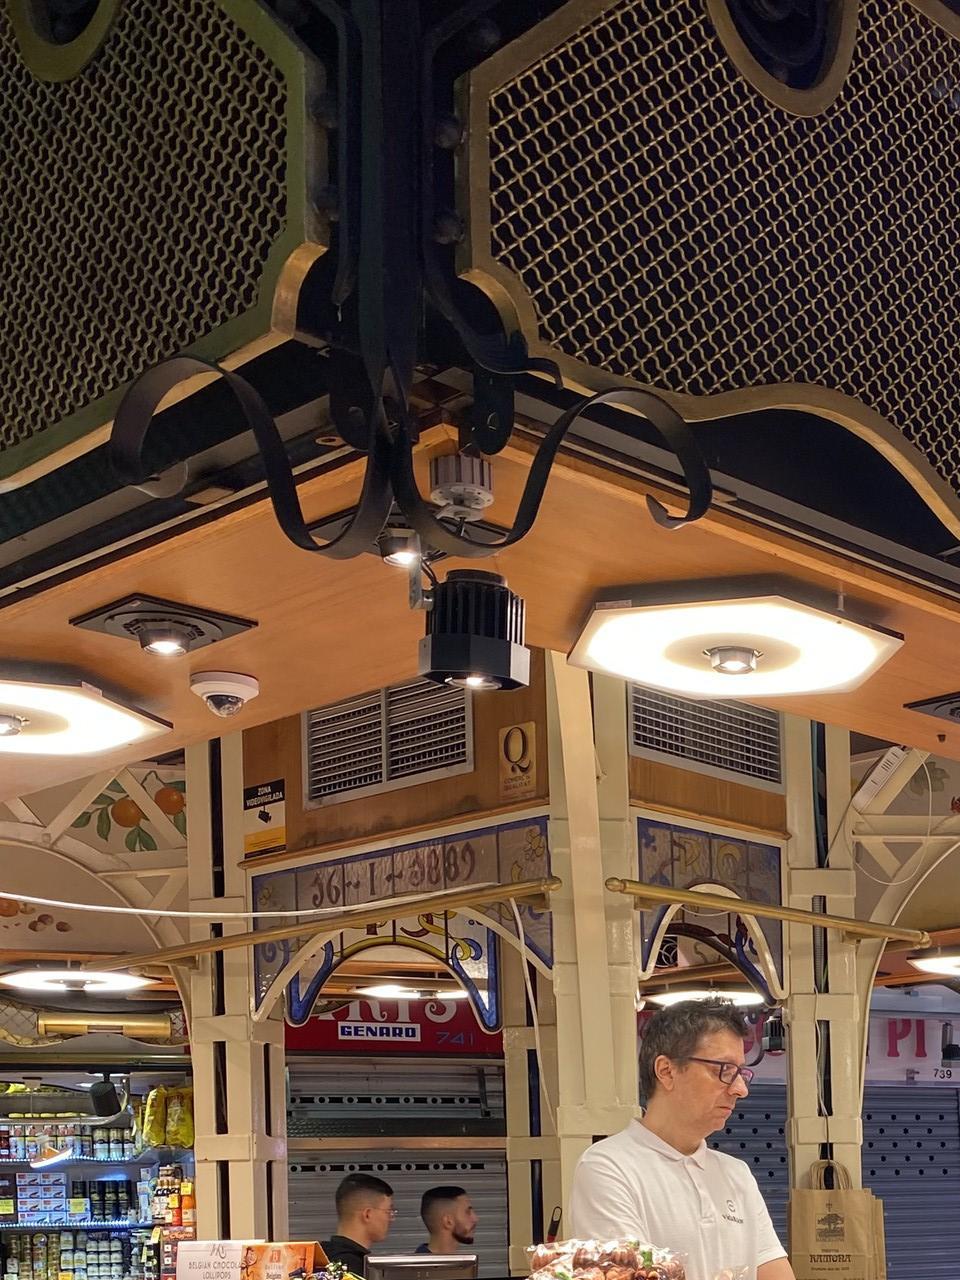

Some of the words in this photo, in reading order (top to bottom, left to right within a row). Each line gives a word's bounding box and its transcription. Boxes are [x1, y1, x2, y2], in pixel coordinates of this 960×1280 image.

[503, 726, 532, 773] Q
[257, 785, 272, 796] ZONA
[340, 1025, 416, 1038] GENARO
[436, 1031, 473, 1046] 741
[933, 1068, 952, 1079] 739
[809, 1254, 852, 1263] RAMONA
[188, 1261, 212, 1270] BELGIAN
[202, 1271, 231, 1280] LOLLIPOPS
